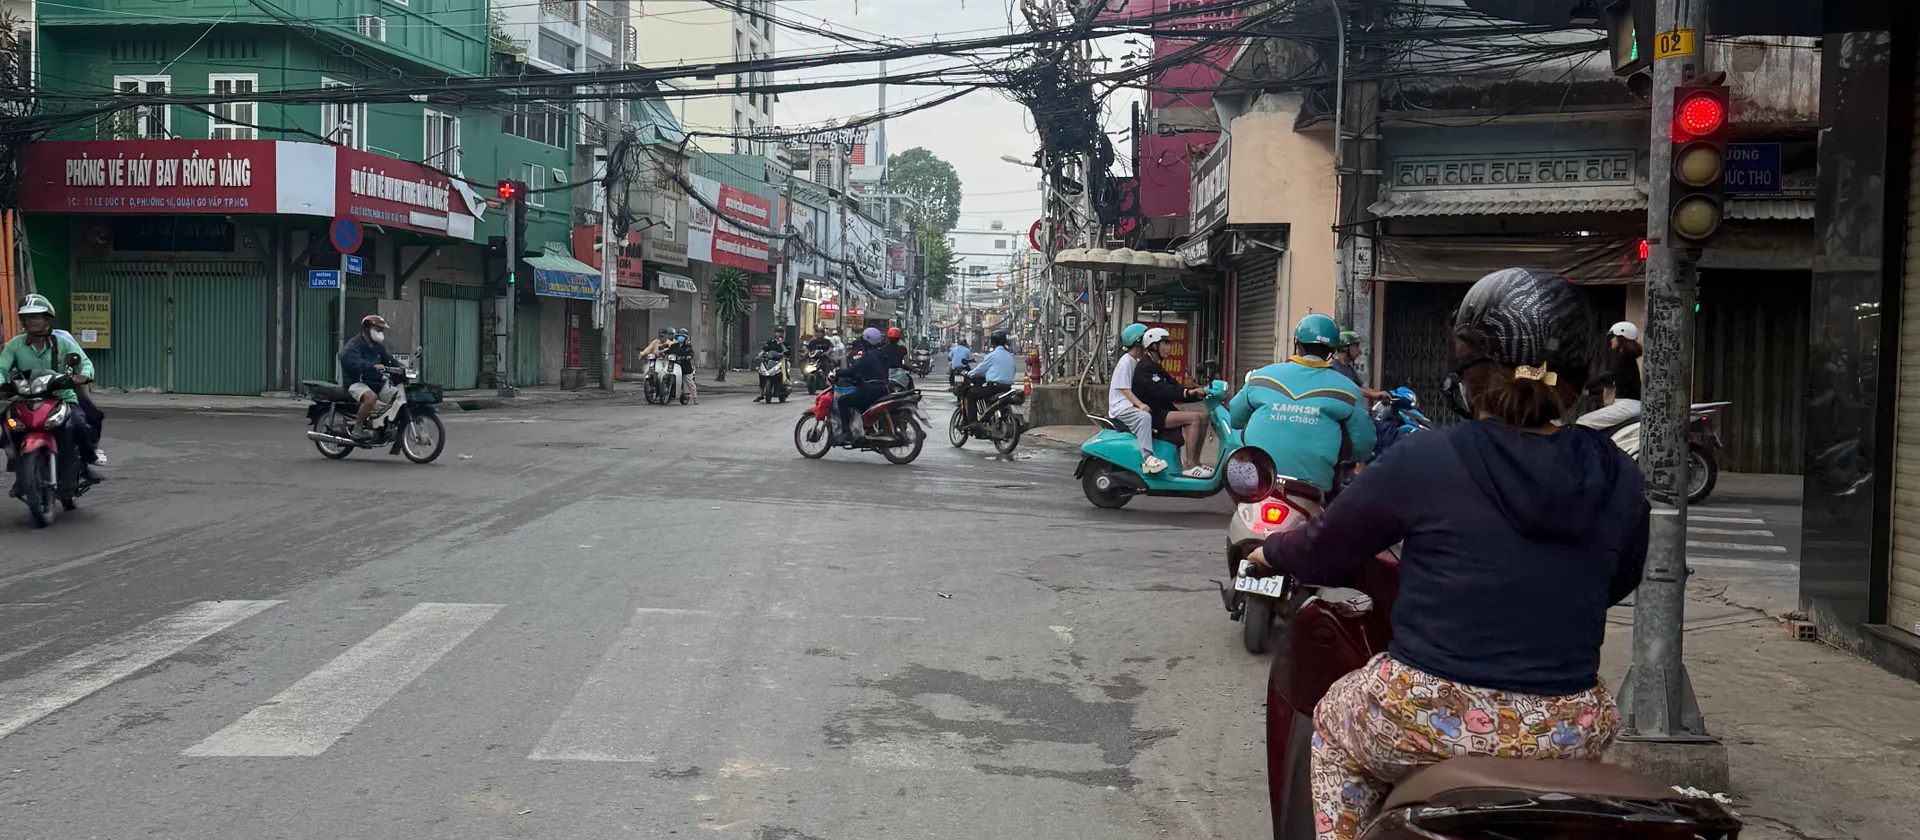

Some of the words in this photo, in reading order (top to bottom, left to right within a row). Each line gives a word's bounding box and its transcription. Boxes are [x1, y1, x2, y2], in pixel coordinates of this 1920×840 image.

[1661, 34, 1682, 54] 02
[1725, 146, 1760, 160] ƯỜNG
[66, 152, 105, 187] PHÒNG
[108, 153, 125, 187] VÉ
[128, 153, 153, 187] MÁY
[156, 159, 179, 187] BAY
[183, 149, 215, 187] RỒNG
[219, 152, 251, 187] VÀNG
